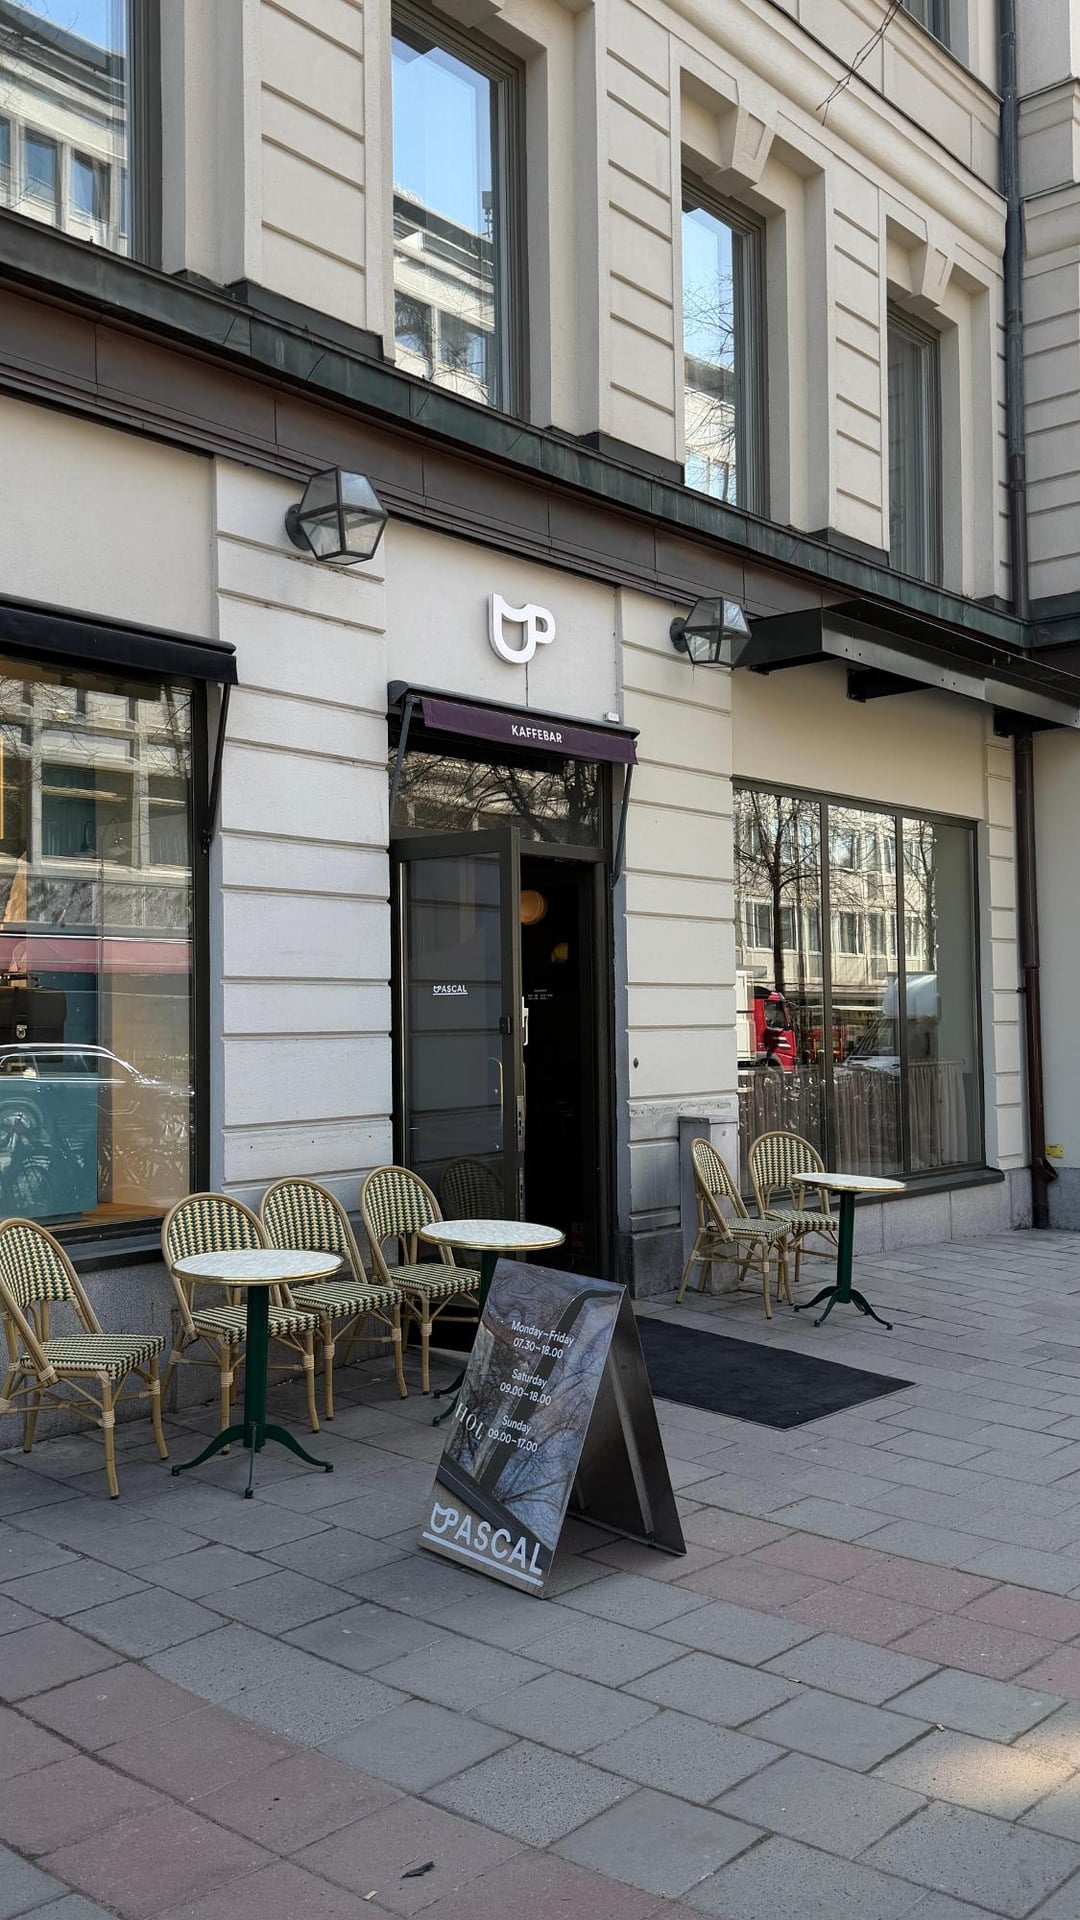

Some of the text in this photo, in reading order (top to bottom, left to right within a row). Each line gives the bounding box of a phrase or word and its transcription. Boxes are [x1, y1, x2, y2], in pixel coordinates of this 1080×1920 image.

[511, 724, 563, 744] KAFFEBAR
[511, 1320, 575, 1348] Monday–Friday
[513, 1337, 564, 1359] 07.30–18.00
[511, 1368, 548, 1390] Saturday
[500, 1382, 552, 1406] 09.00–18.00
[501, 1414, 532, 1436] Sunday
[487, 1428, 538, 1452] 09.00–17.00
